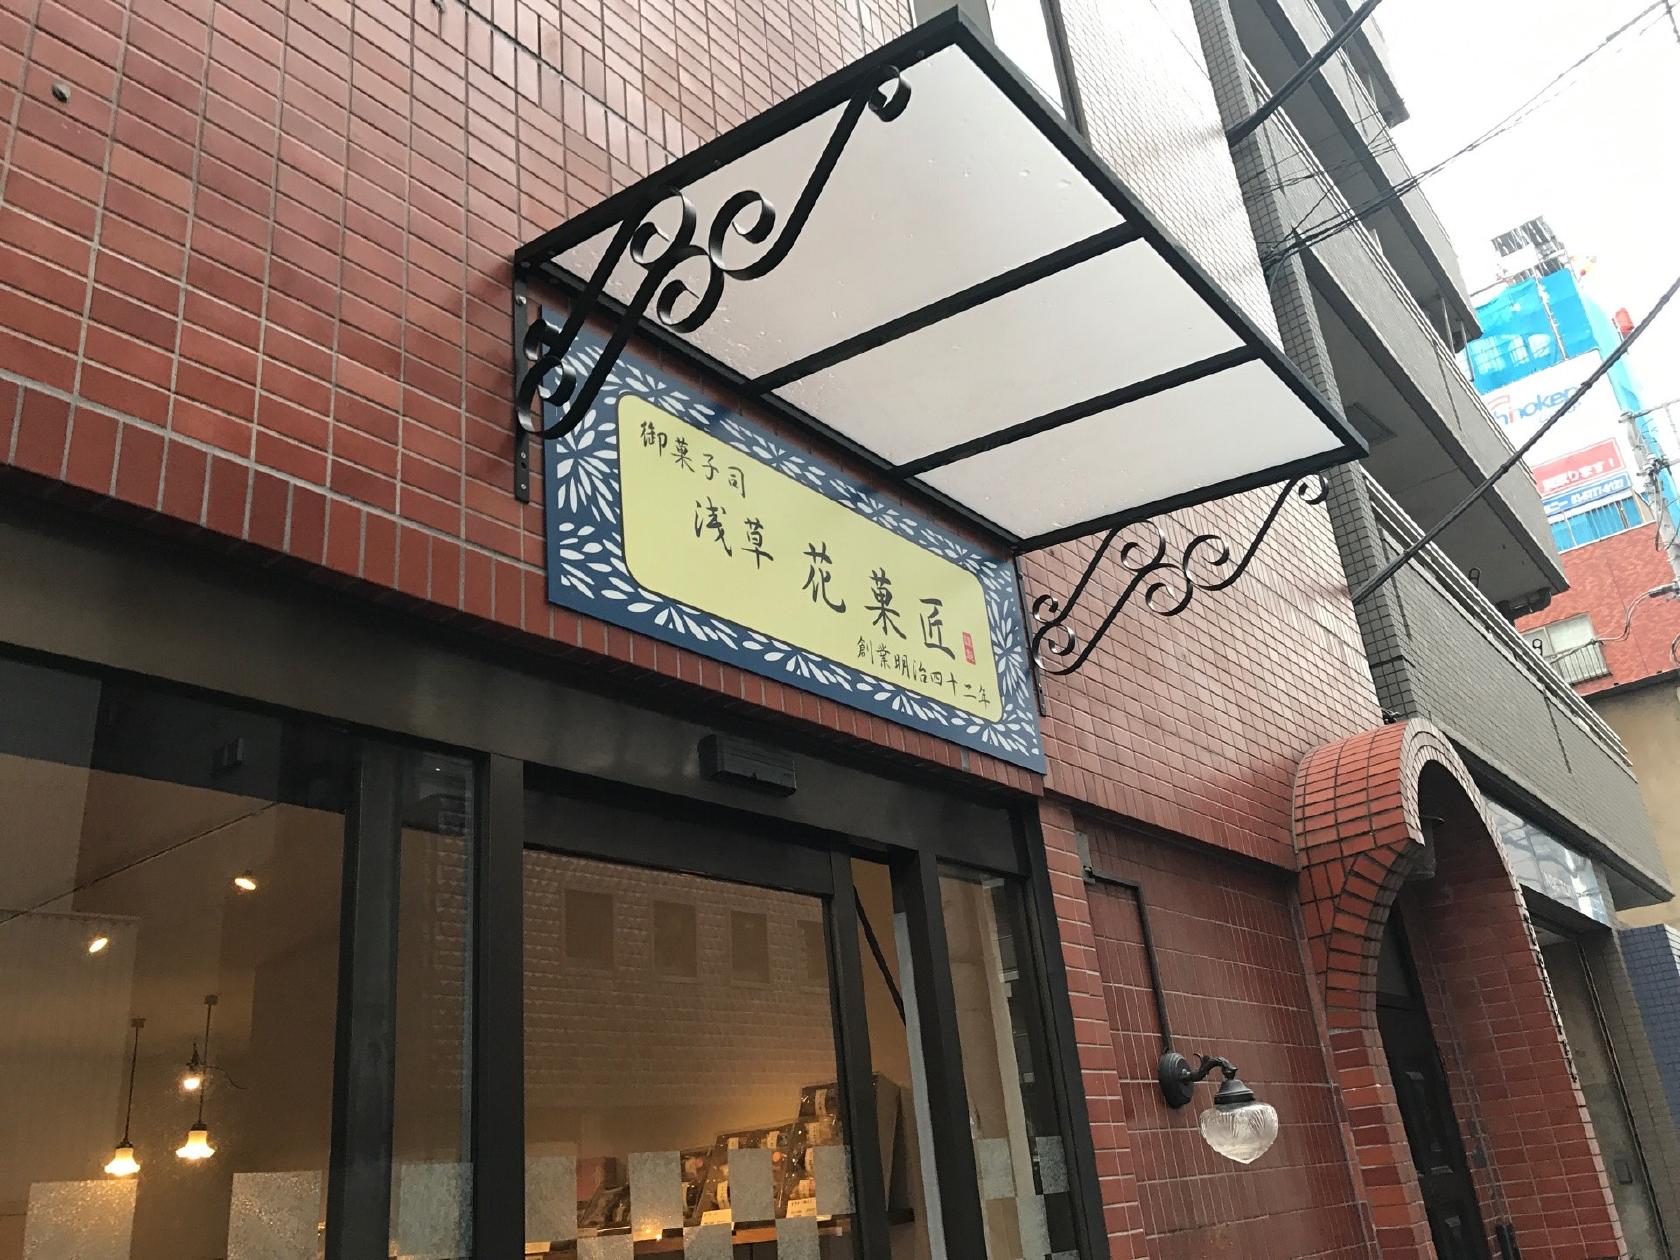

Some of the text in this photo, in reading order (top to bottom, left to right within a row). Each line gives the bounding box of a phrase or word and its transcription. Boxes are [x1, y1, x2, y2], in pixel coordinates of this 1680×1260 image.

[640, 421, 746, 498] 御菓子司
[857, 635, 990, 709] 創業明治四十二年
